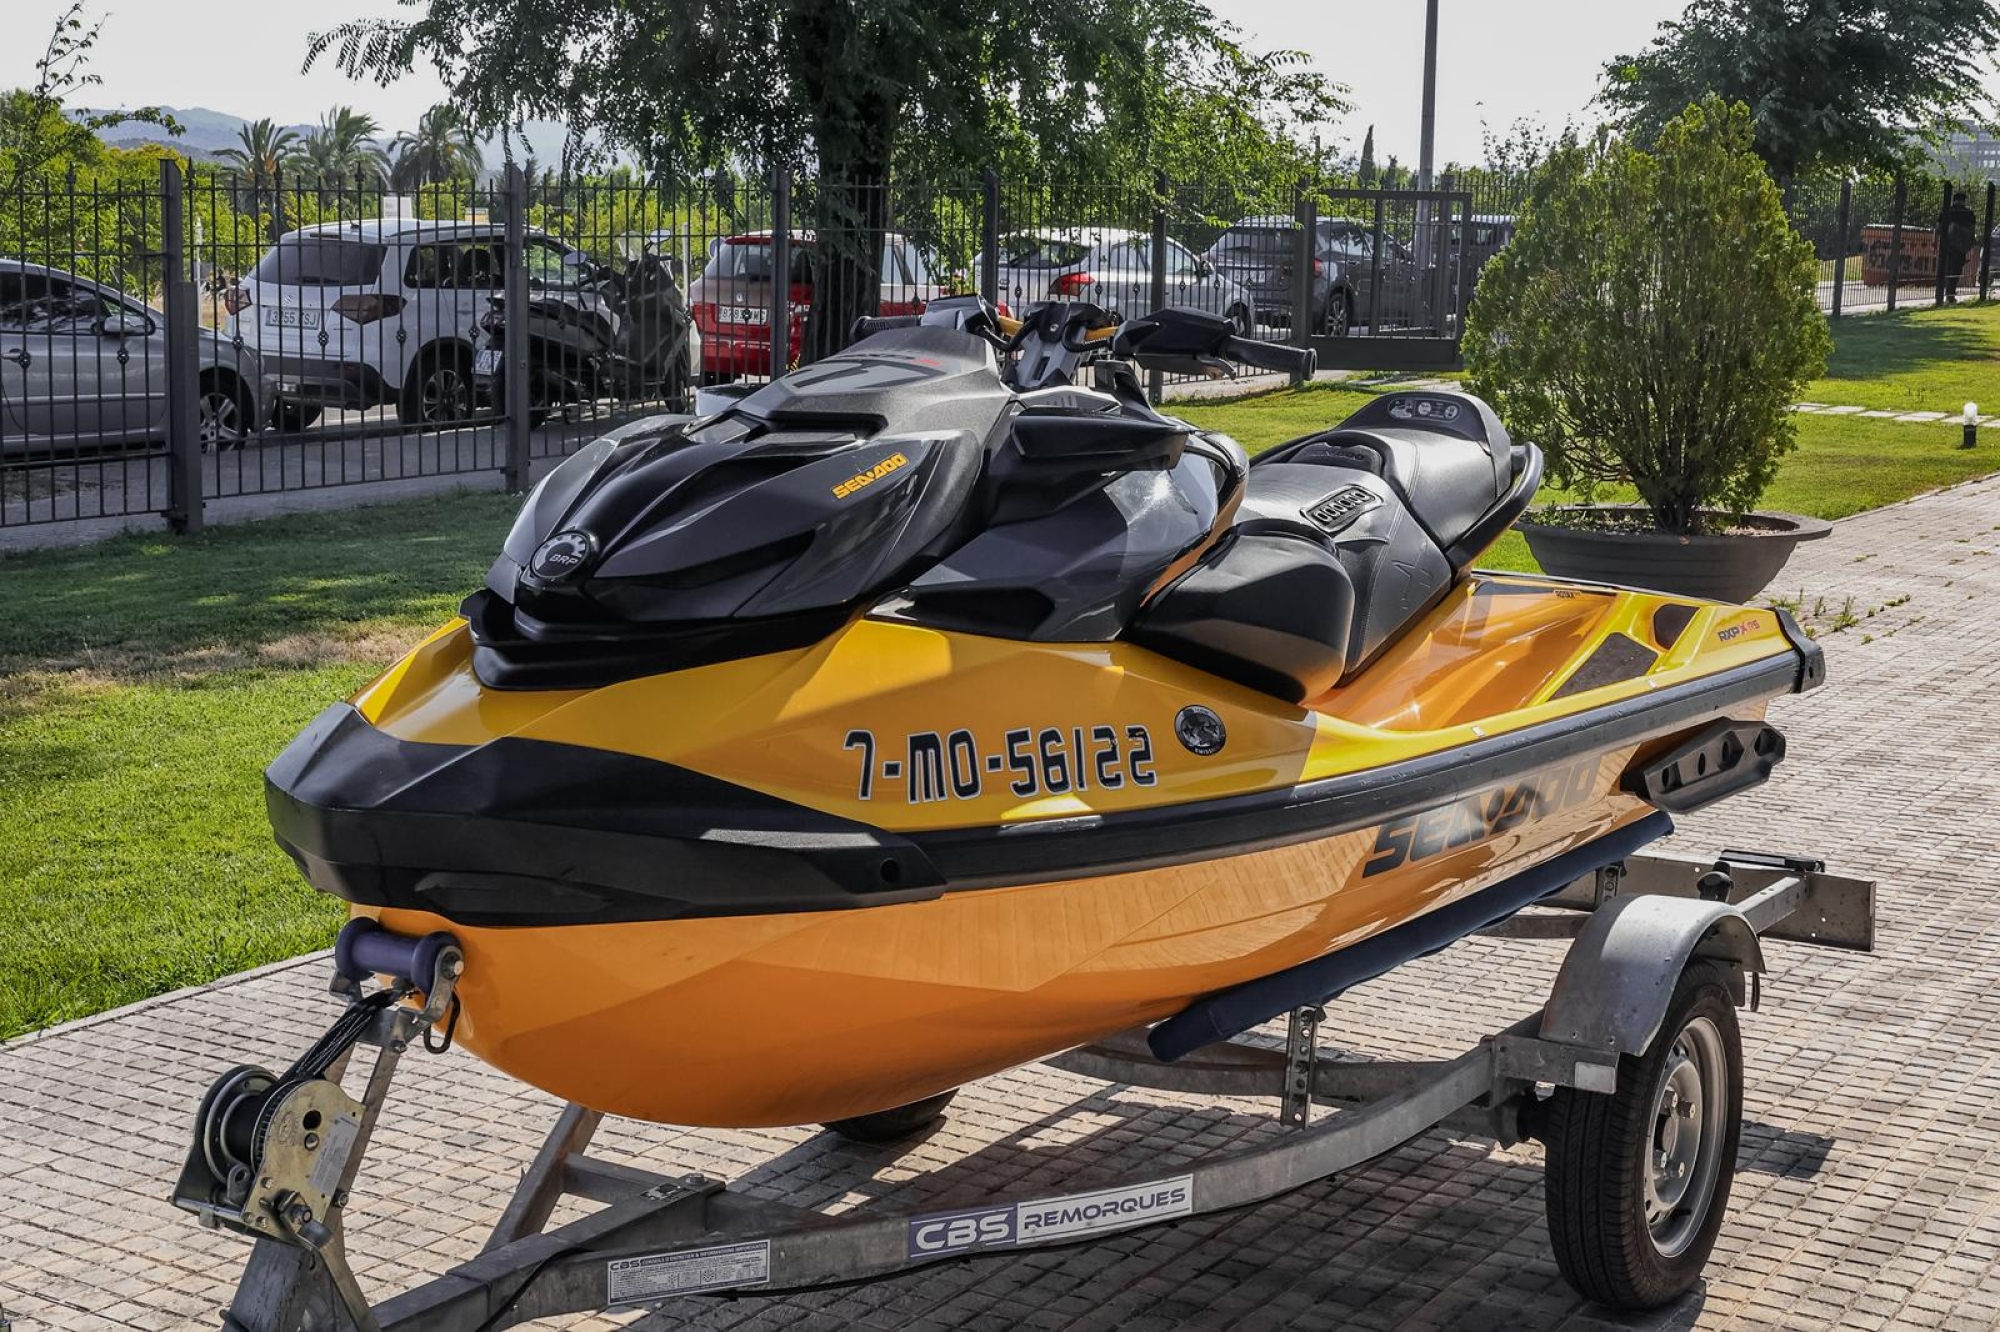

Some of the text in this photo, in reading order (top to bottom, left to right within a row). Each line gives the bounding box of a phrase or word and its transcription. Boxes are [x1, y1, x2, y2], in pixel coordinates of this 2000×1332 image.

[549, 554, 579, 565] BRP
[843, 726, 1157, 804] 7-MO-56122
[916, 1187, 1186, 1250] CBS REMORQUES
[610, 1260, 640, 1271] CBS
